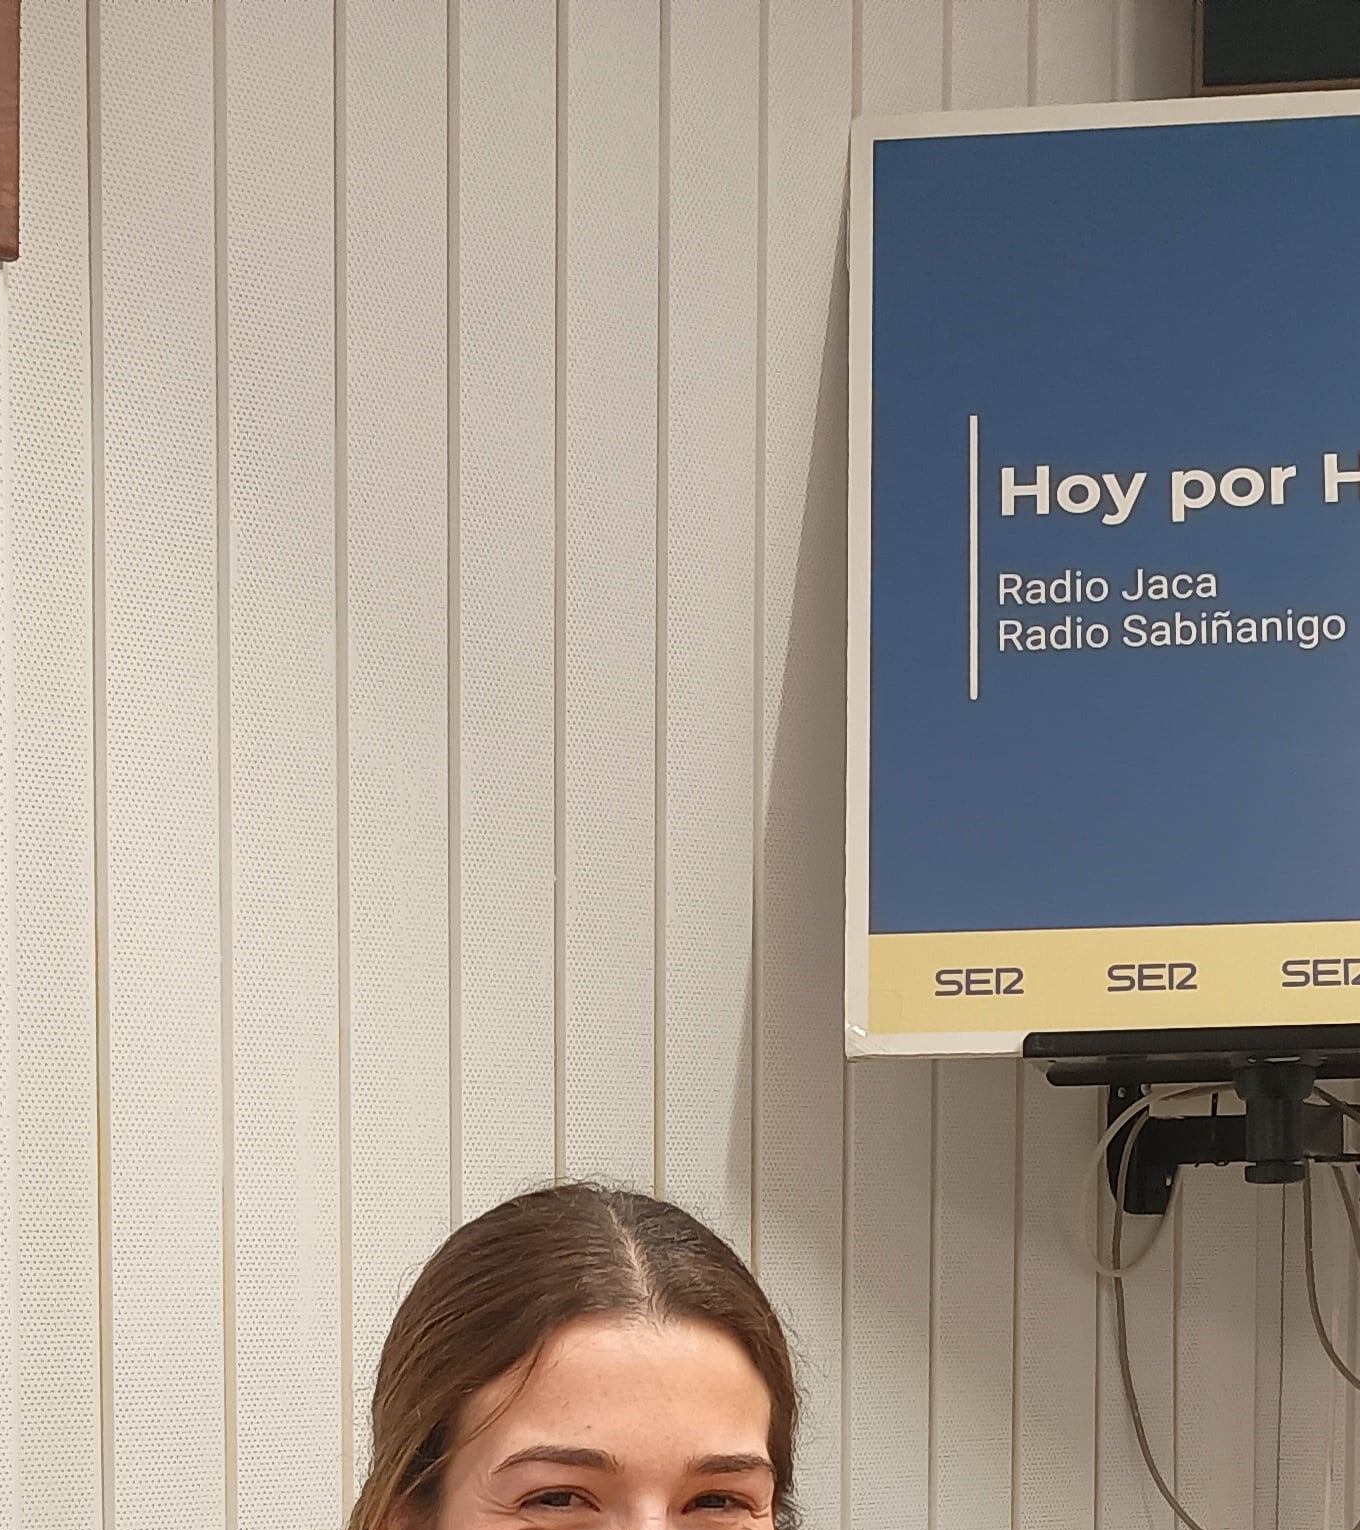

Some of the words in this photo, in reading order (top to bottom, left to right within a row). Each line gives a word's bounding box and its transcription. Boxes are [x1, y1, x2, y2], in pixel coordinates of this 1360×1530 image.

[1000, 465, 1148, 525] Hoy
[1171, 465, 1297, 522] por
[998, 570, 1109, 605] Radio
[1121, 568, 1217, 601] Jaca
[998, 616, 1109, 651] Radio
[1122, 608, 1346, 649] Sabiñanigo
[934, 967, 1025, 997] SER
[1107, 962, 1198, 993] SER
